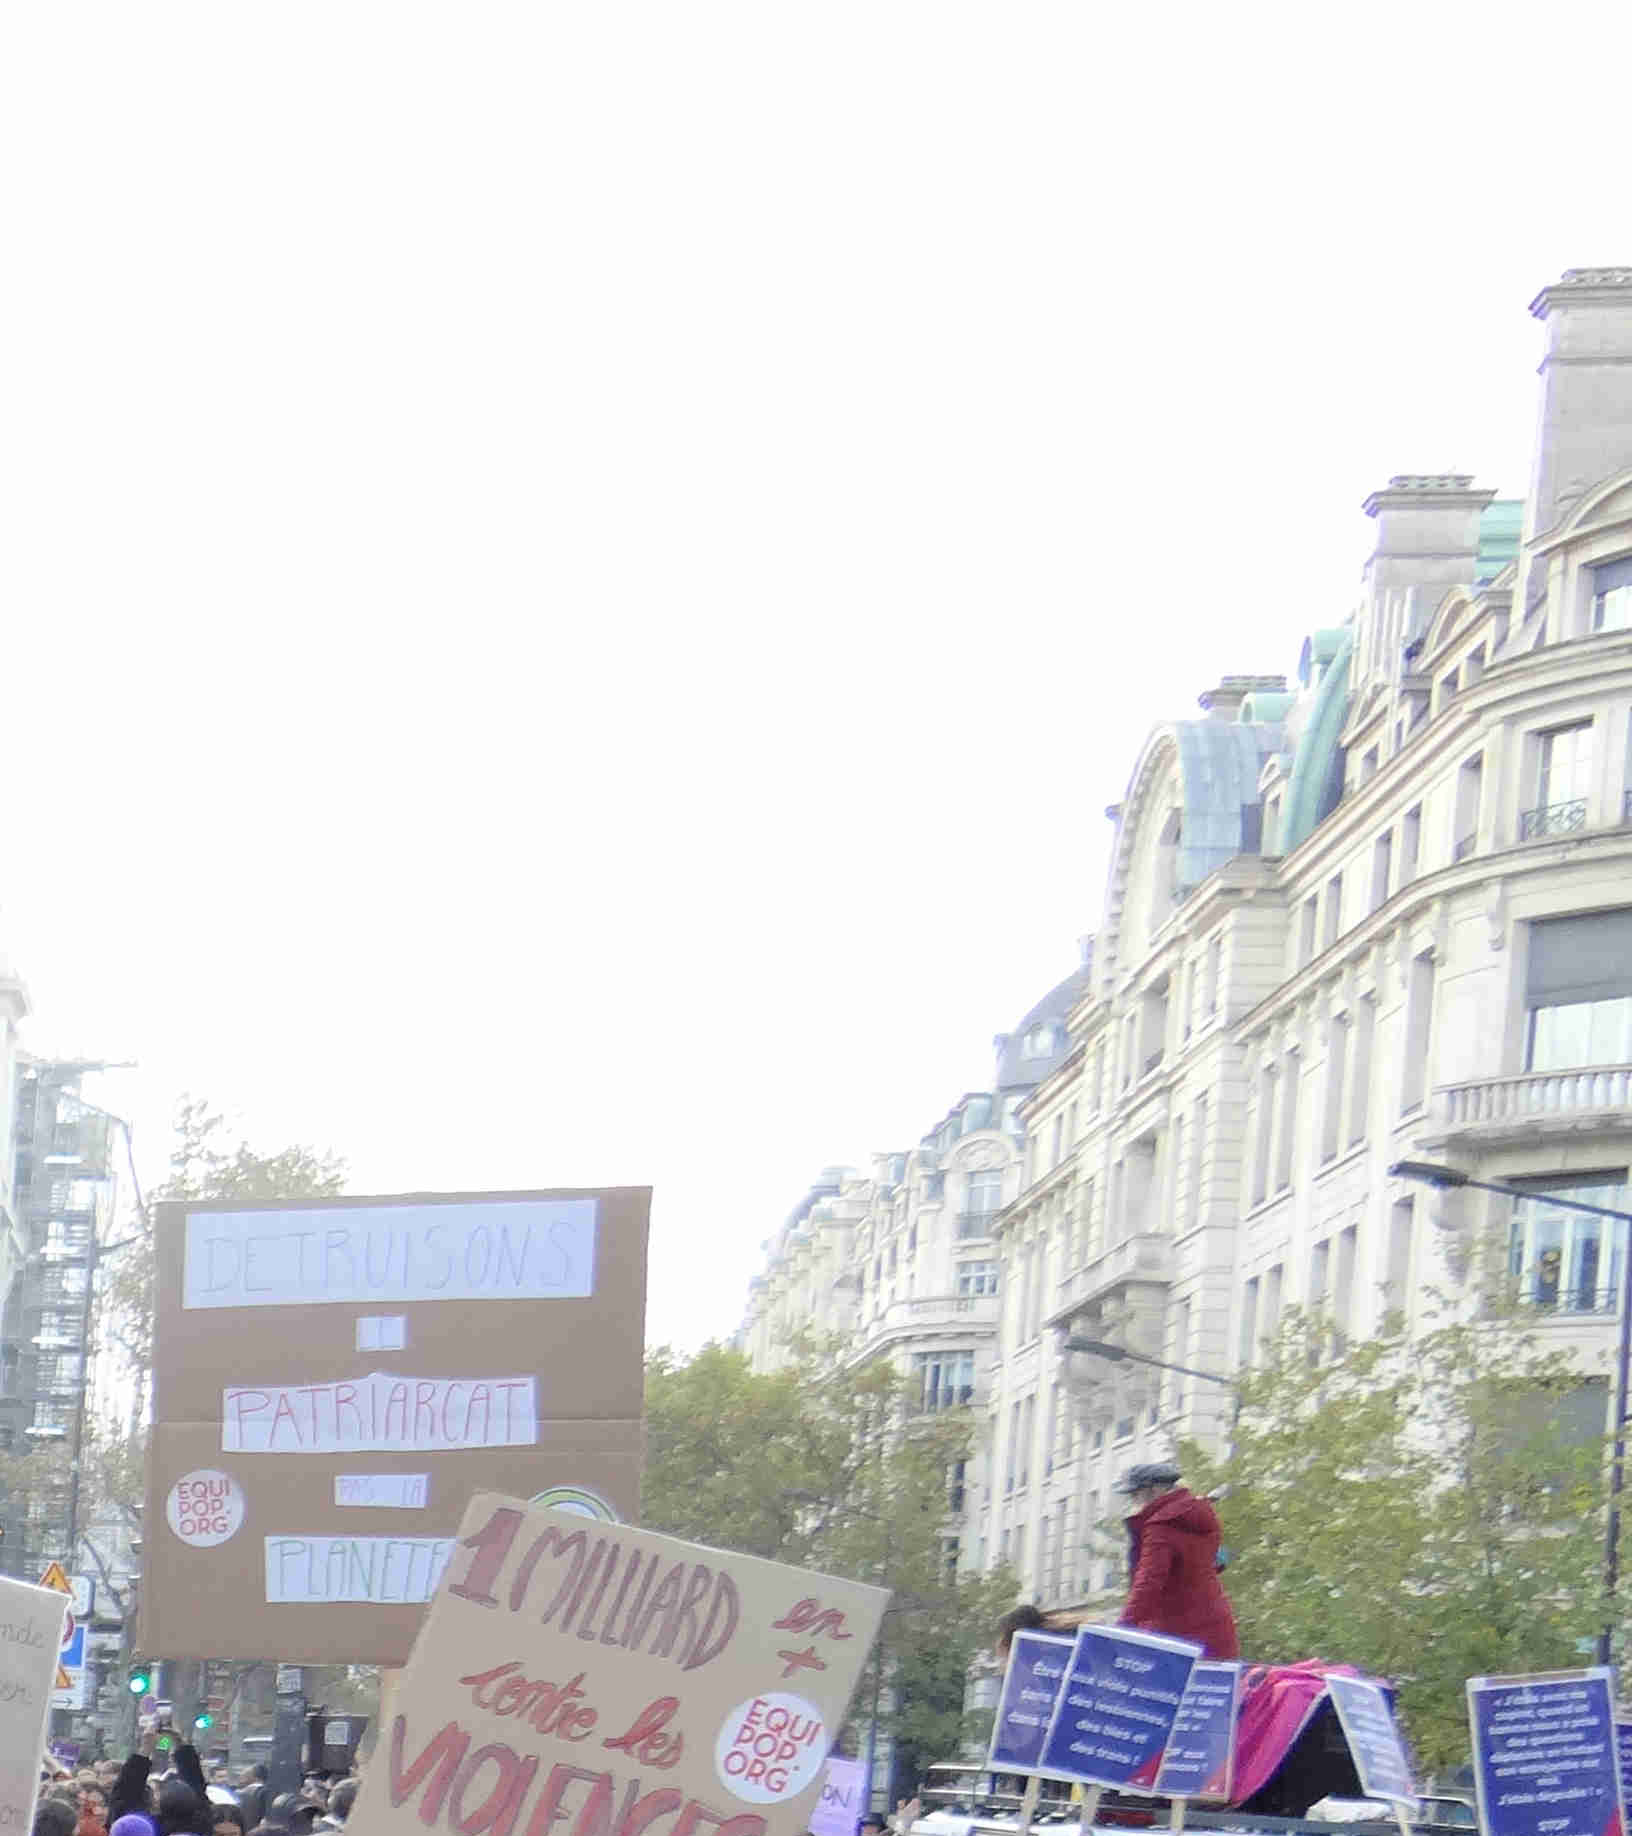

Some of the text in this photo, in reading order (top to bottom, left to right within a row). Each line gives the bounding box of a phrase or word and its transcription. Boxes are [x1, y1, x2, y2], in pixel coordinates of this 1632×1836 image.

[227, 1380, 528, 1447] PATRIARCAT
[178, 1480, 231, 1500] EQUI
[179, 1516, 229, 1536] ORG
[447, 1508, 526, 1609] 1
[510, 1528, 741, 1672] MILLIARD
[1113, 1656, 1153, 1673] STOP
[746, 1699, 823, 1747] EQUI
[724, 1750, 789, 1793] ORG
